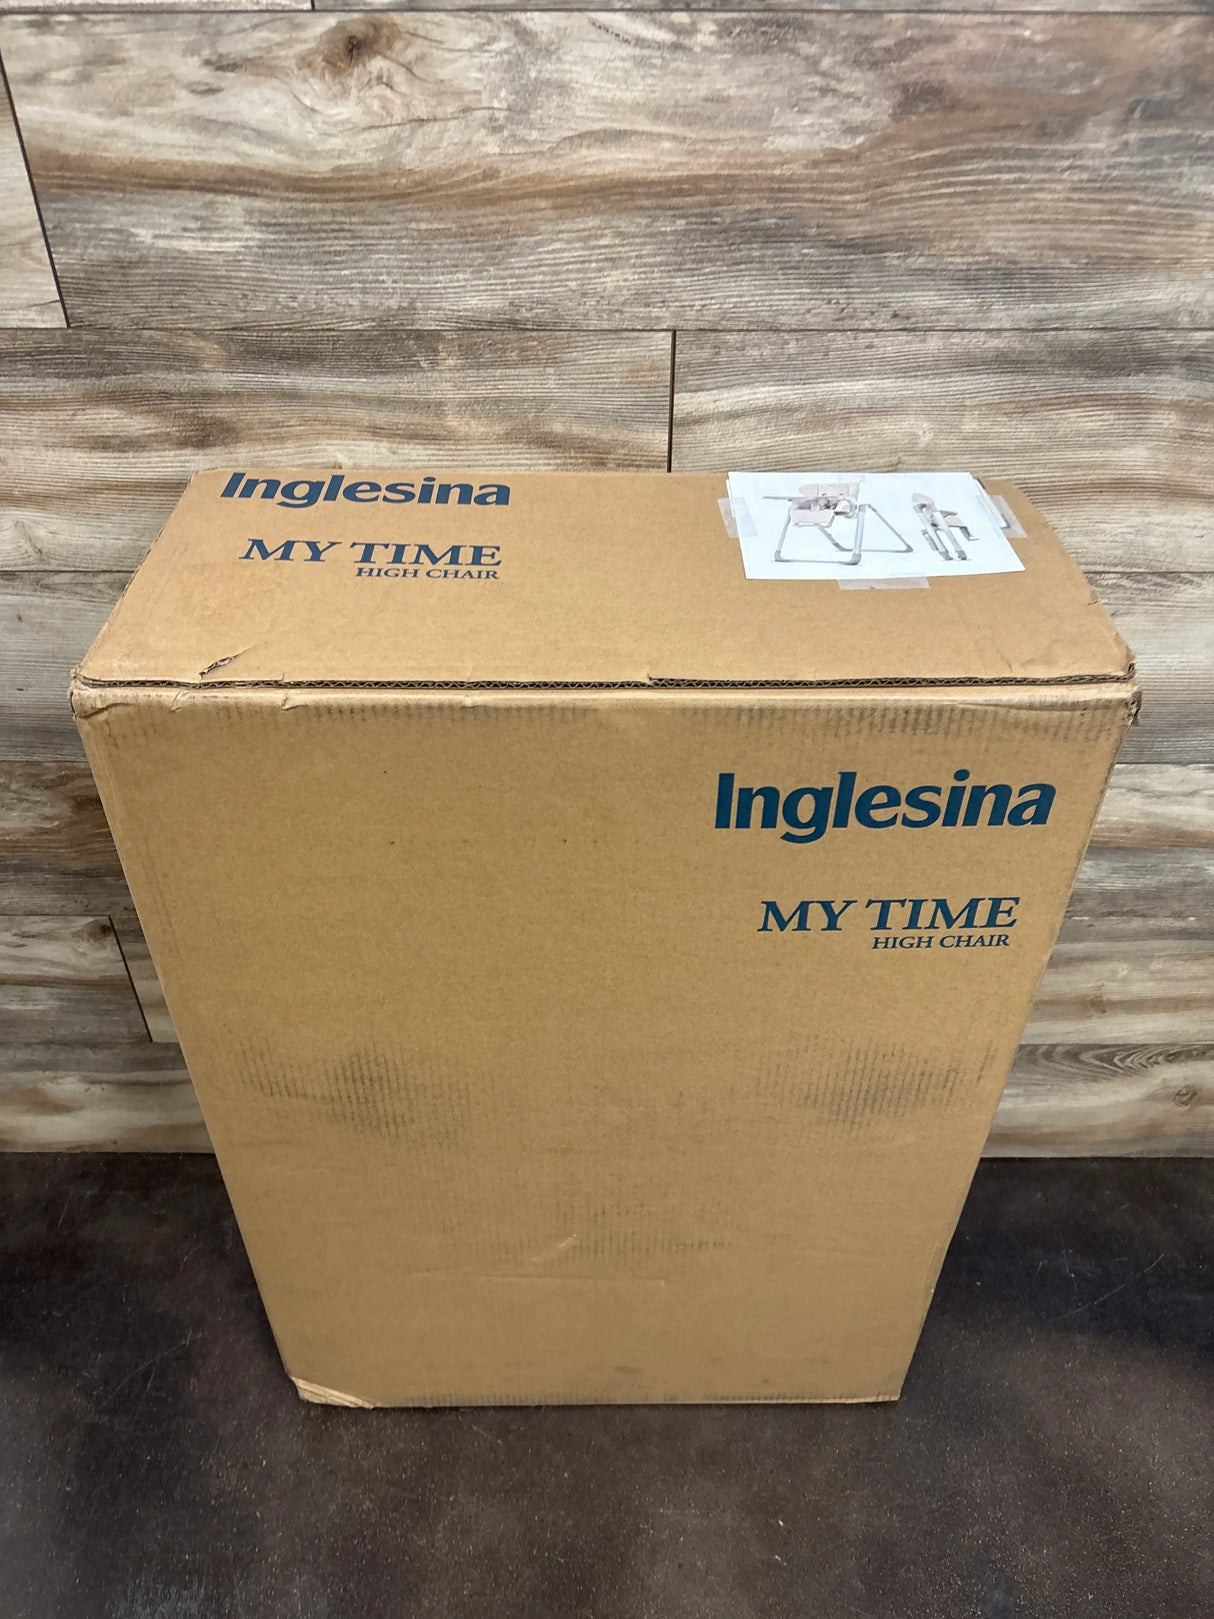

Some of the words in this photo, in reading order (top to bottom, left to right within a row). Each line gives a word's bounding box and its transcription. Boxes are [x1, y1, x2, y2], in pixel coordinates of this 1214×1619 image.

[220, 472, 511, 508] Inglesina
[239, 539, 343, 562] MY
[349, 542, 503, 567] TIME
[355, 567, 420, 579] HIGH
[425, 568, 500, 580] CHAIR
[715, 769, 1056, 844] Inglesina
[757, 900, 858, 932] MY
[865, 897, 1021, 931] TIME
[872, 936, 934, 949] HIGH
[939, 934, 1011, 948] CHAIR
